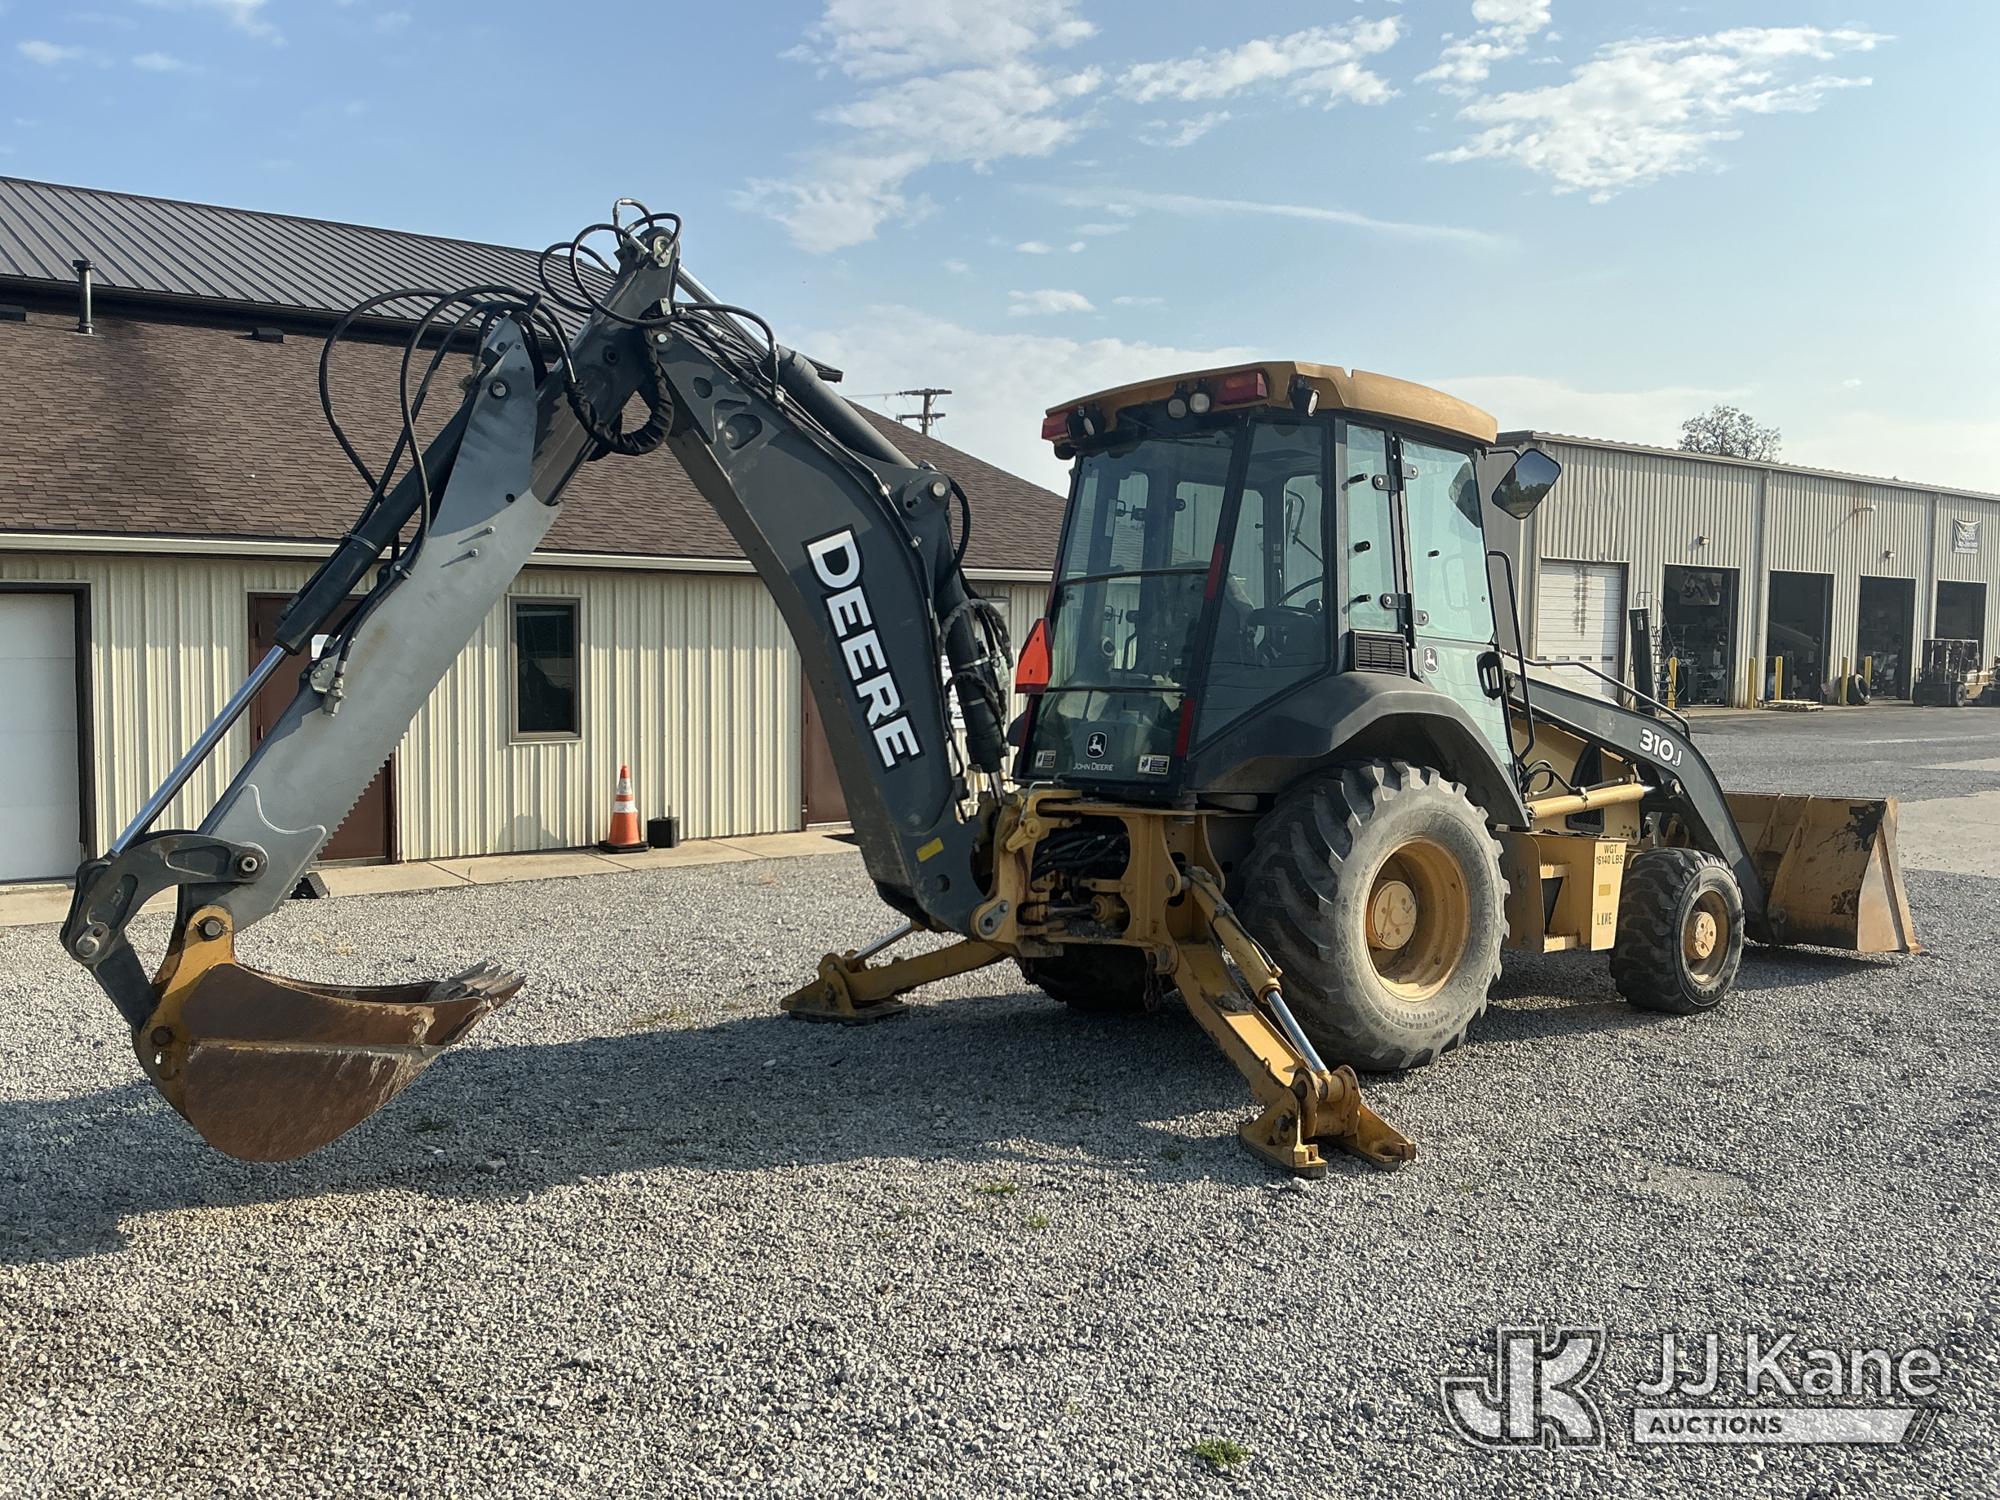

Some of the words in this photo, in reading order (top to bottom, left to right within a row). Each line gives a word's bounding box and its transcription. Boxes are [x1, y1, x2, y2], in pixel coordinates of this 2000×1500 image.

[807, 530, 920, 768] DEERE
[1640, 728, 1682, 767] 310J
[1072, 761, 1091, 770] JOHN
[1091, 762, 1114, 771] DEERE
[1603, 844, 1618, 854] WGT
[1611, 854, 1624, 865] LBS
